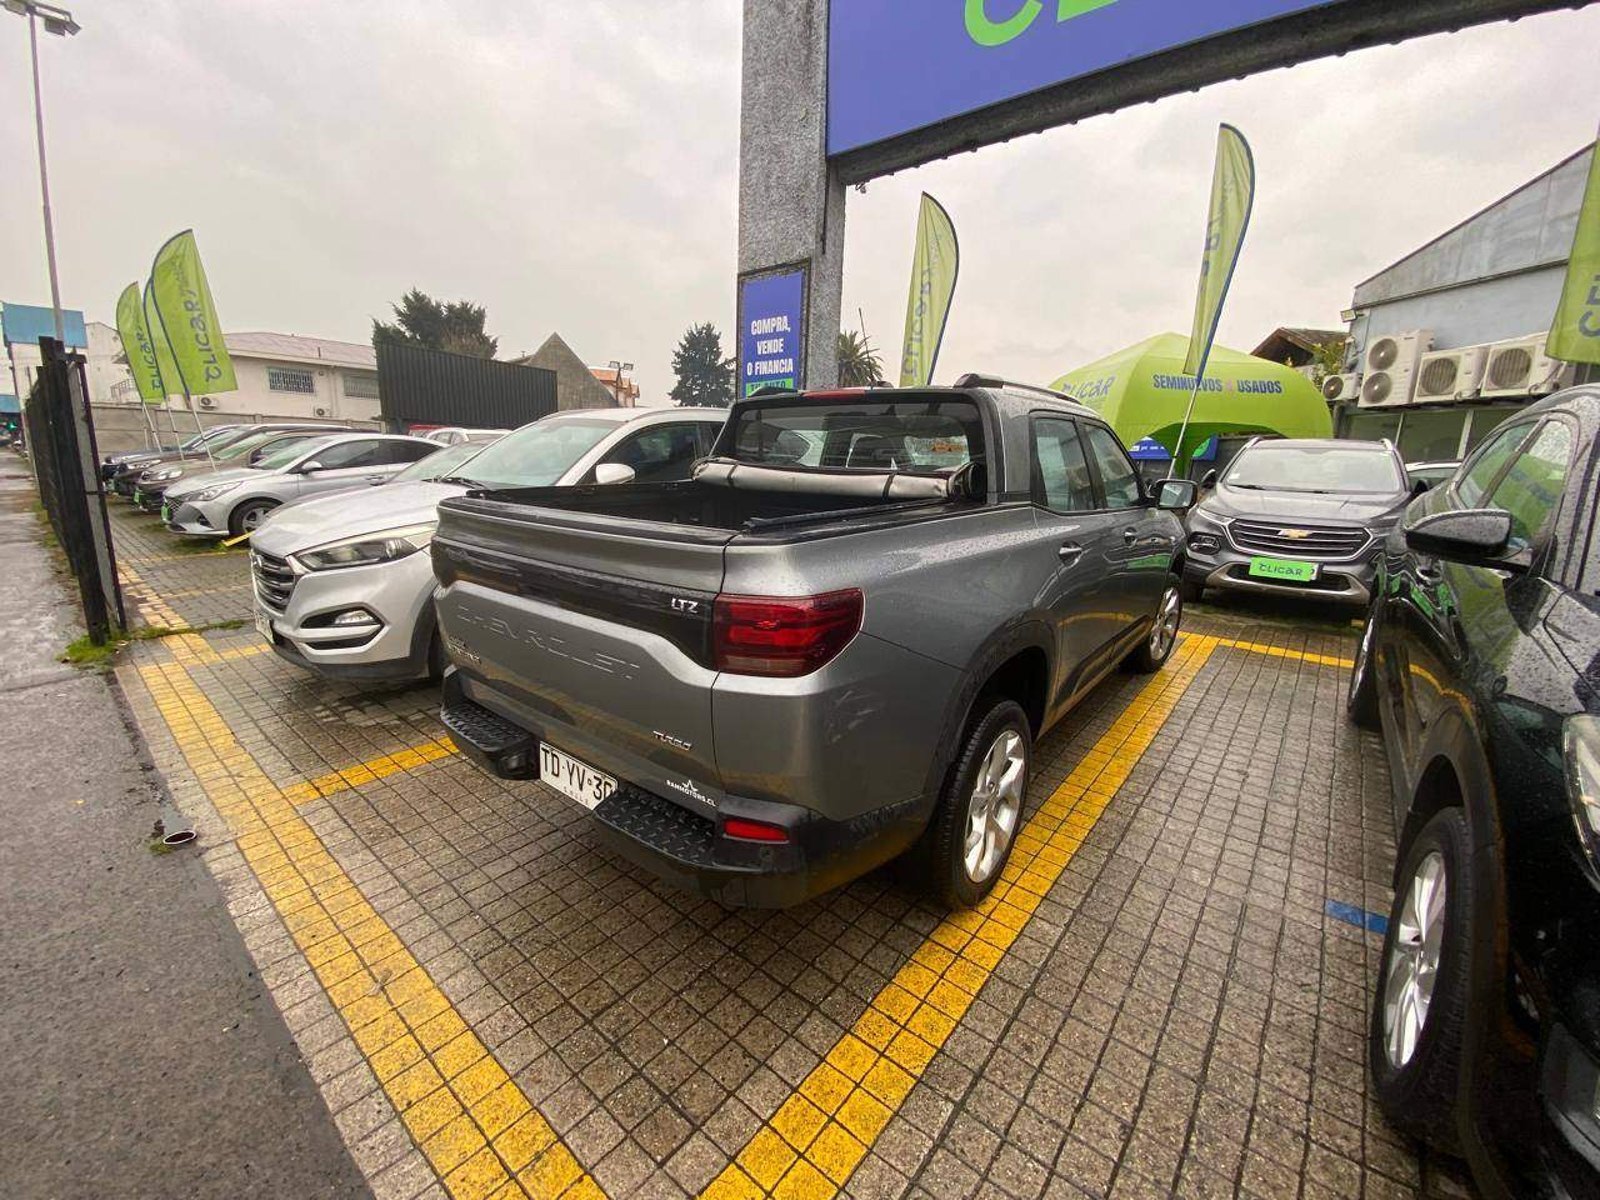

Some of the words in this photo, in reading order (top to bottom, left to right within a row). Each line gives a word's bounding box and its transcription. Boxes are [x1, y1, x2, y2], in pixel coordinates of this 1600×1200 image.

[751, 315, 791, 336] COMPRA,
[757, 339, 784, 355] VENDE
[746, 361, 752, 376] O
[754, 358, 793, 376] FINANCIA
[1236, 380, 1283, 394] USADOS
[670, 598, 699, 614] LTZ
